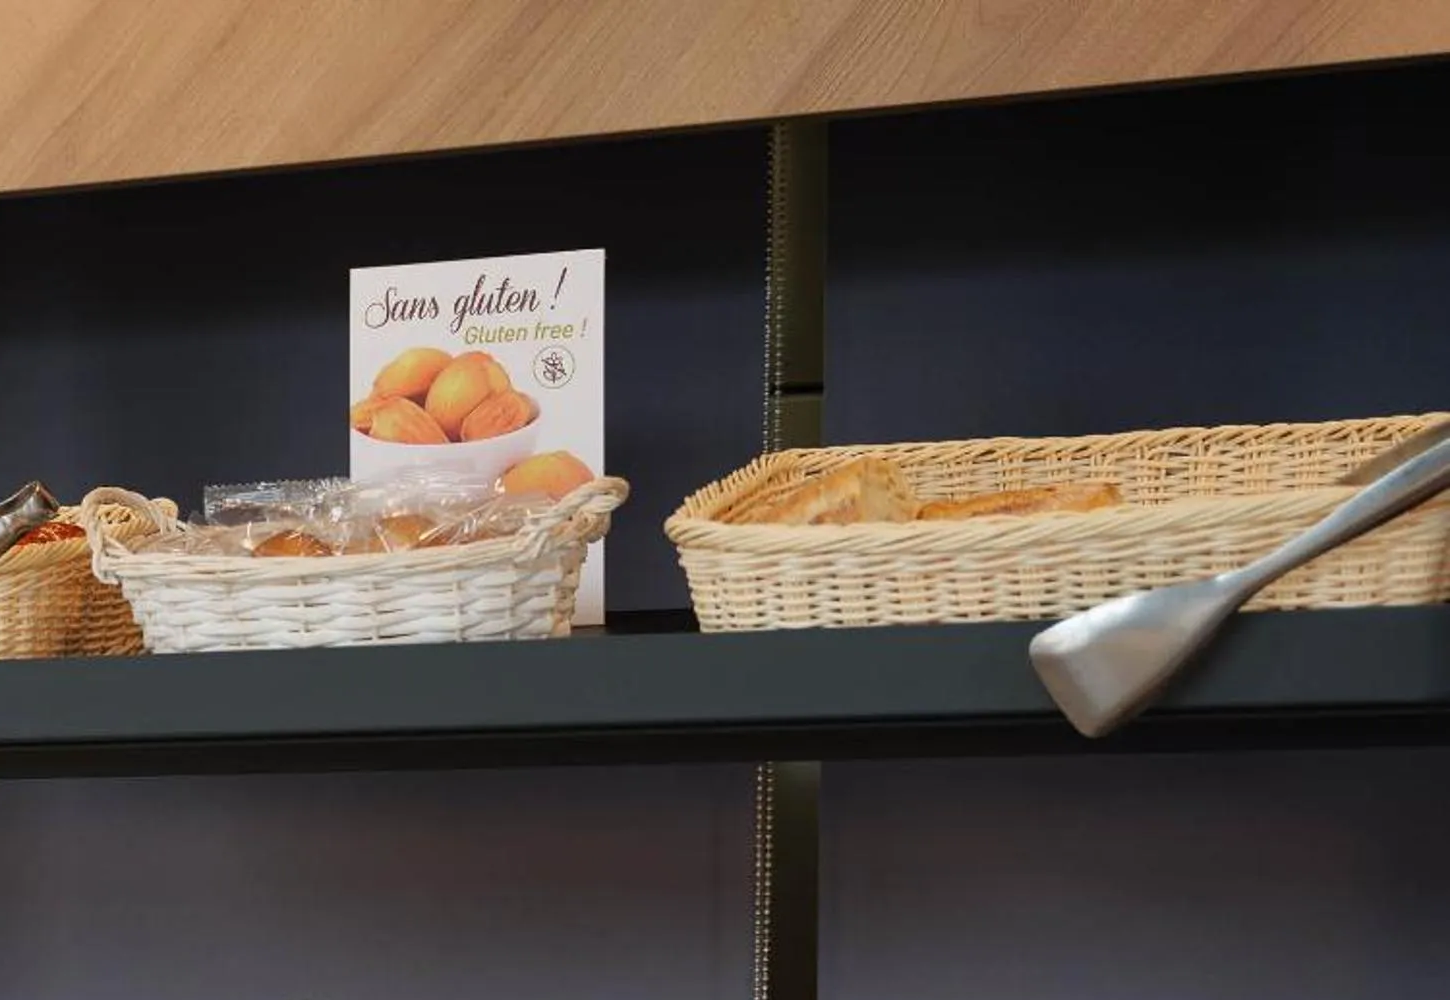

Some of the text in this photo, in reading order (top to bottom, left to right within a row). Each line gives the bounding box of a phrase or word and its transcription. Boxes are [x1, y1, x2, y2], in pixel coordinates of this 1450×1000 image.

[364, 267, 568, 335] Sans gluten !
[463, 318, 588, 345] Gluten free !
